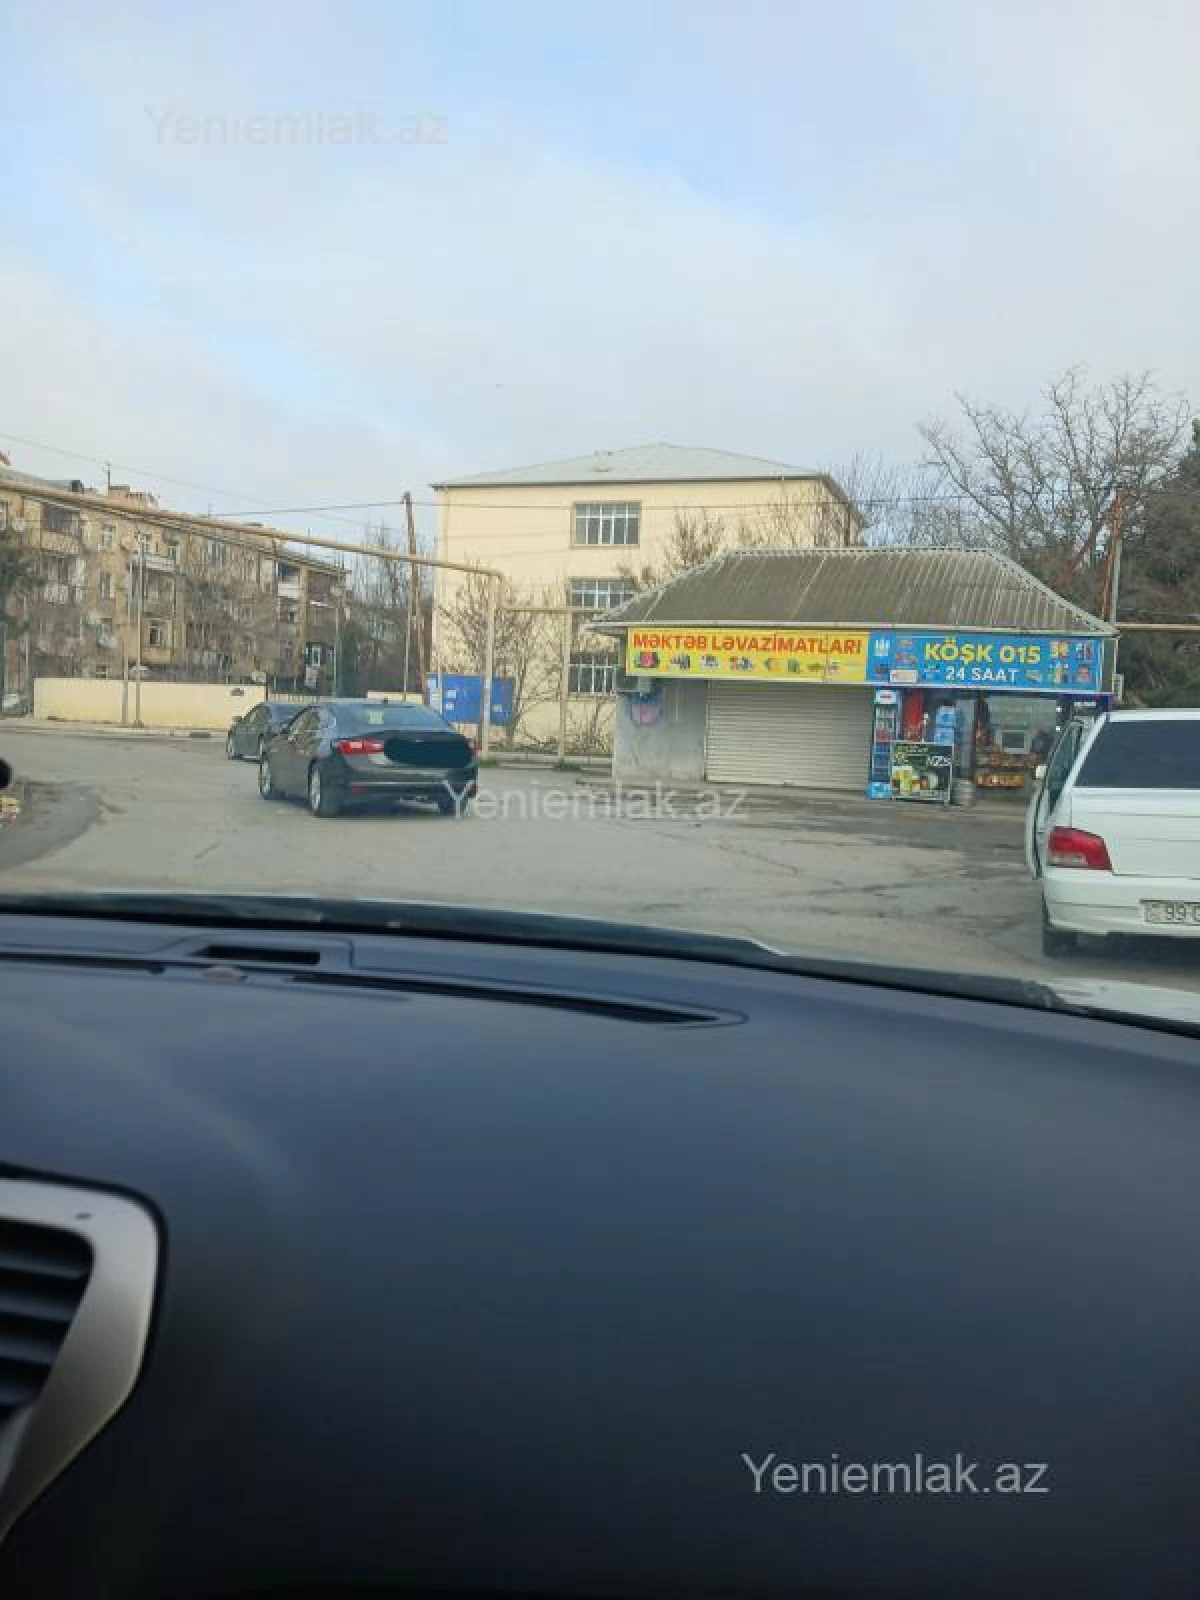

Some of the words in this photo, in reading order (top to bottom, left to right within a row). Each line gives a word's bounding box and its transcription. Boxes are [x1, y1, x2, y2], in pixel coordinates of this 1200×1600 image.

[924, 637, 993, 665] KÖŞK
[945, 667, 965, 681] 24
[971, 667, 1019, 682] SAAT
